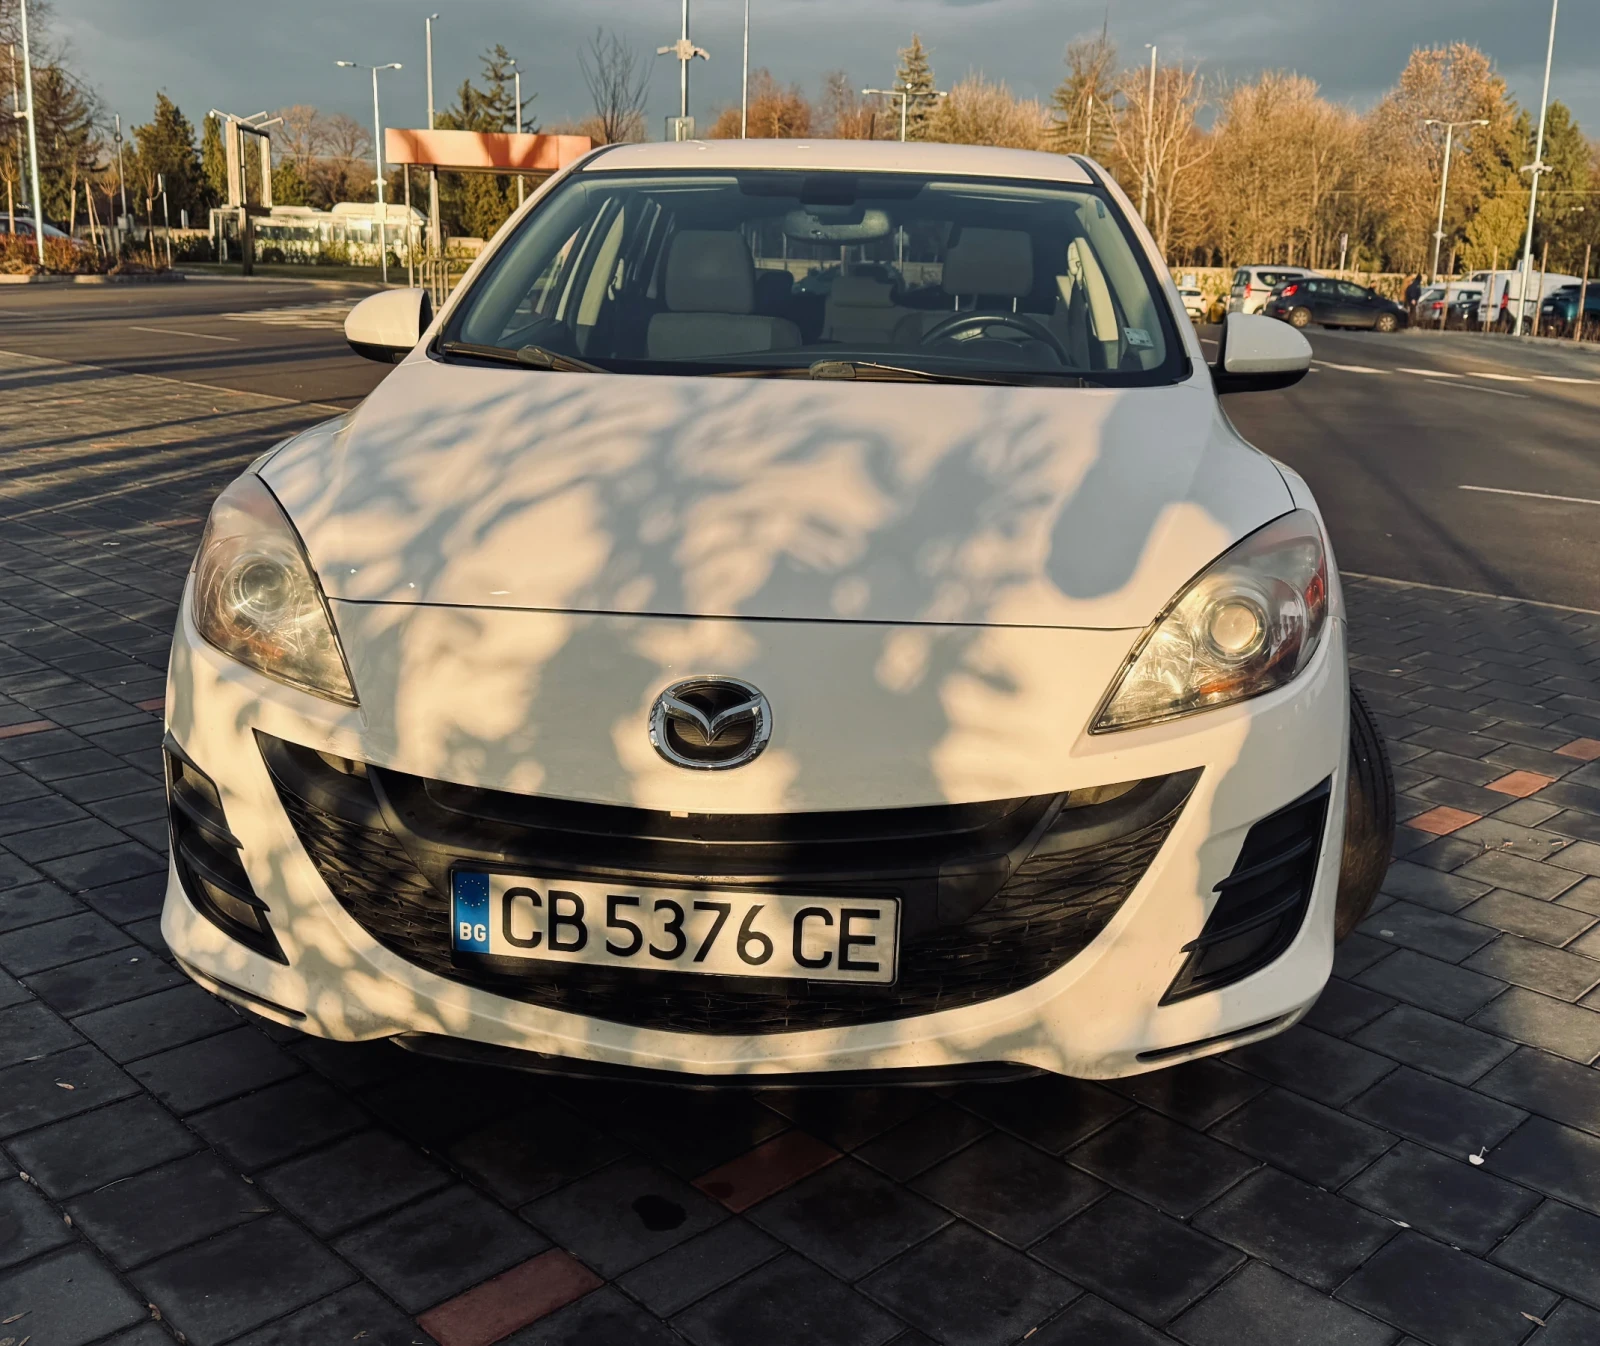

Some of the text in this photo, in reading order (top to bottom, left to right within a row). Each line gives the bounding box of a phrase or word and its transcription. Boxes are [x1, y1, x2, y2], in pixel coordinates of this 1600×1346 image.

[459, 921, 487, 942] BG
[501, 886, 880, 972] CB 5376 CE
